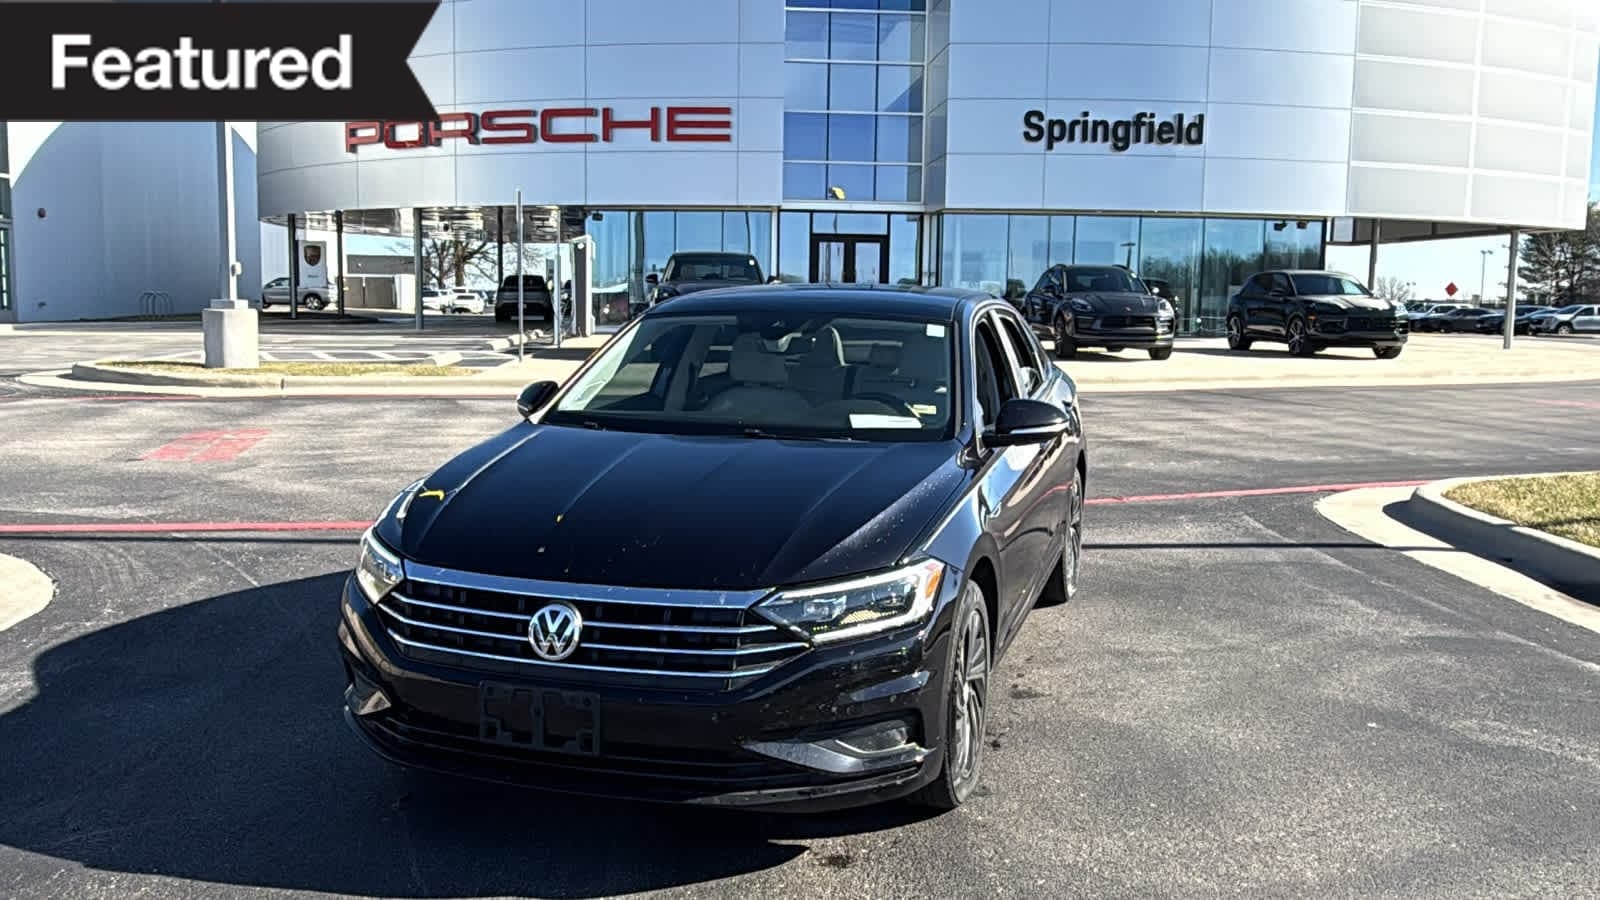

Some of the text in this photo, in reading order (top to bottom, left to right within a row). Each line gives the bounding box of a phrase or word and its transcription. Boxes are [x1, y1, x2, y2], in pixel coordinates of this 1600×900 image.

[345, 106, 732, 153] PORSCHE
[1023, 110, 1205, 152] Springfield
[529, 604, 581, 660] VW
